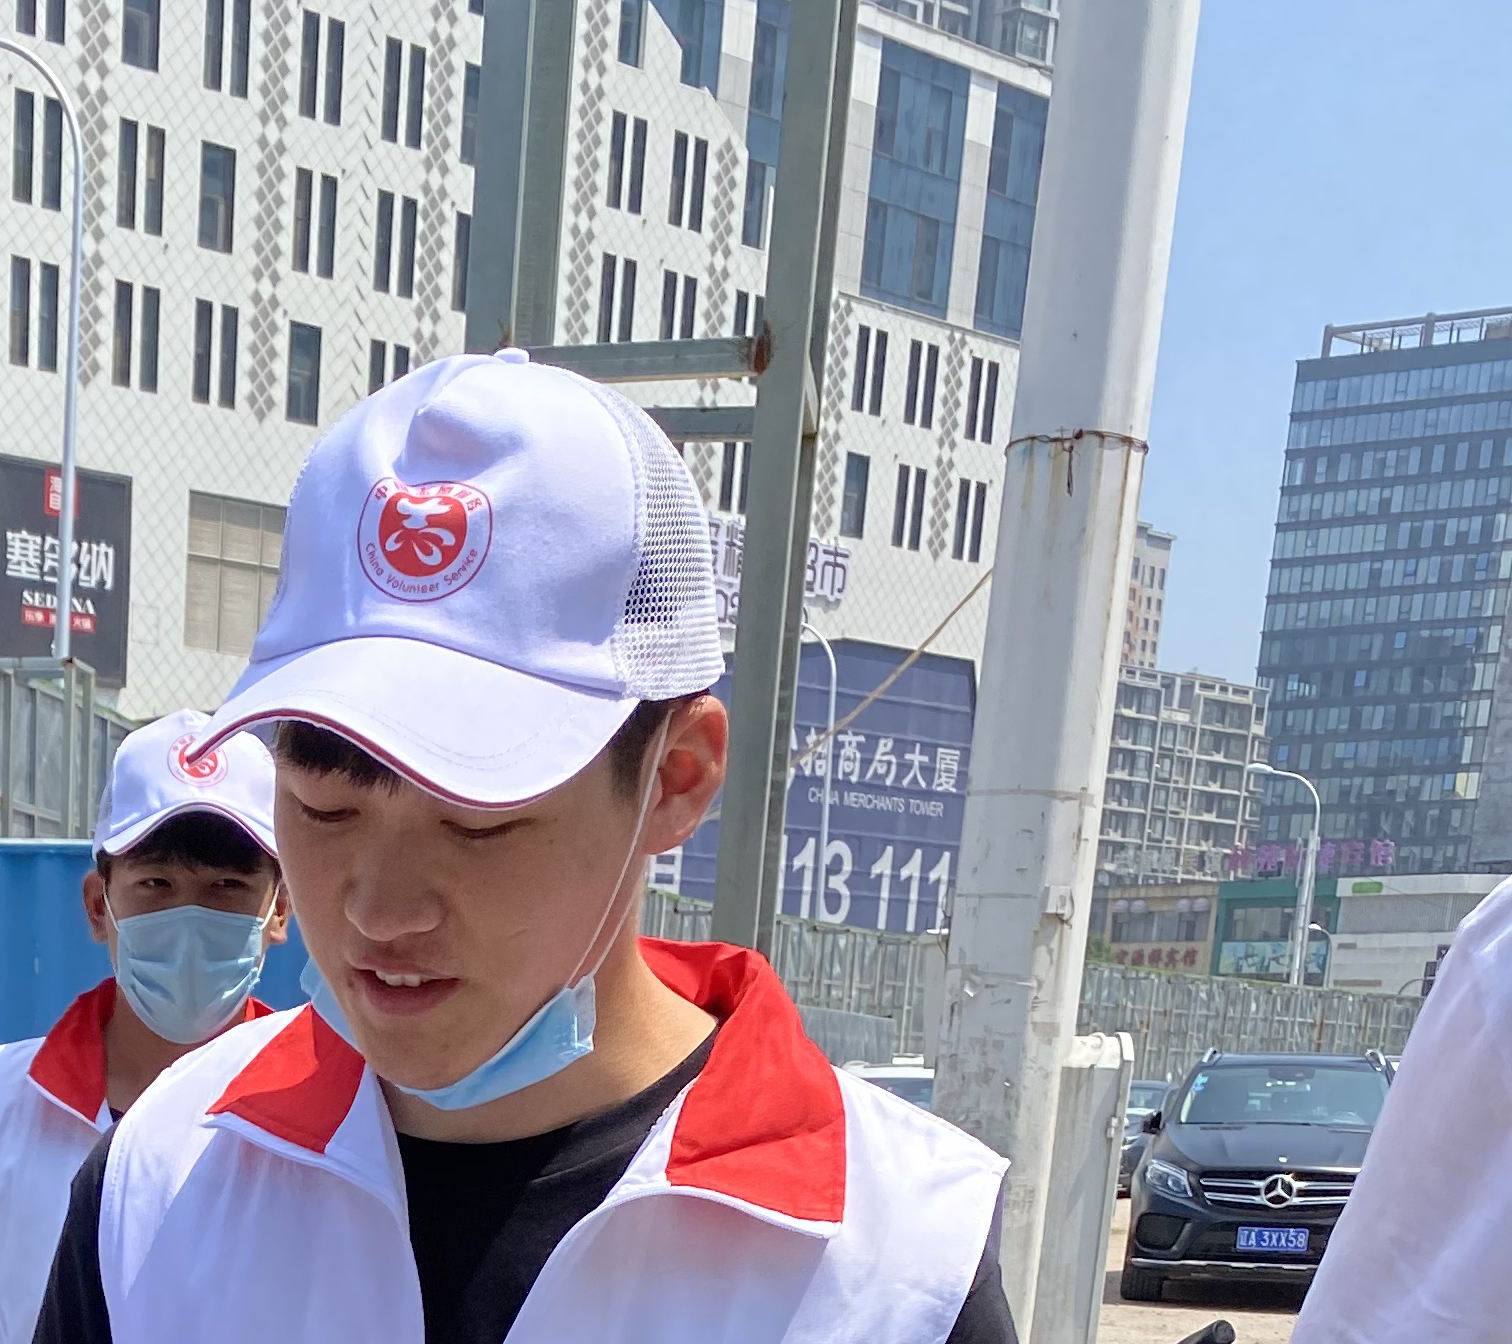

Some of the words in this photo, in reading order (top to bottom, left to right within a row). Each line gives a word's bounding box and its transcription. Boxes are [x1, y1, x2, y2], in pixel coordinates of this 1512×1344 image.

[22, 589, 97, 615] SEDNA
[800, 727, 961, 793] 招商局大厦
[843, 791, 905, 813] MERCHANTS
[909, 799, 944, 818] TOWER
